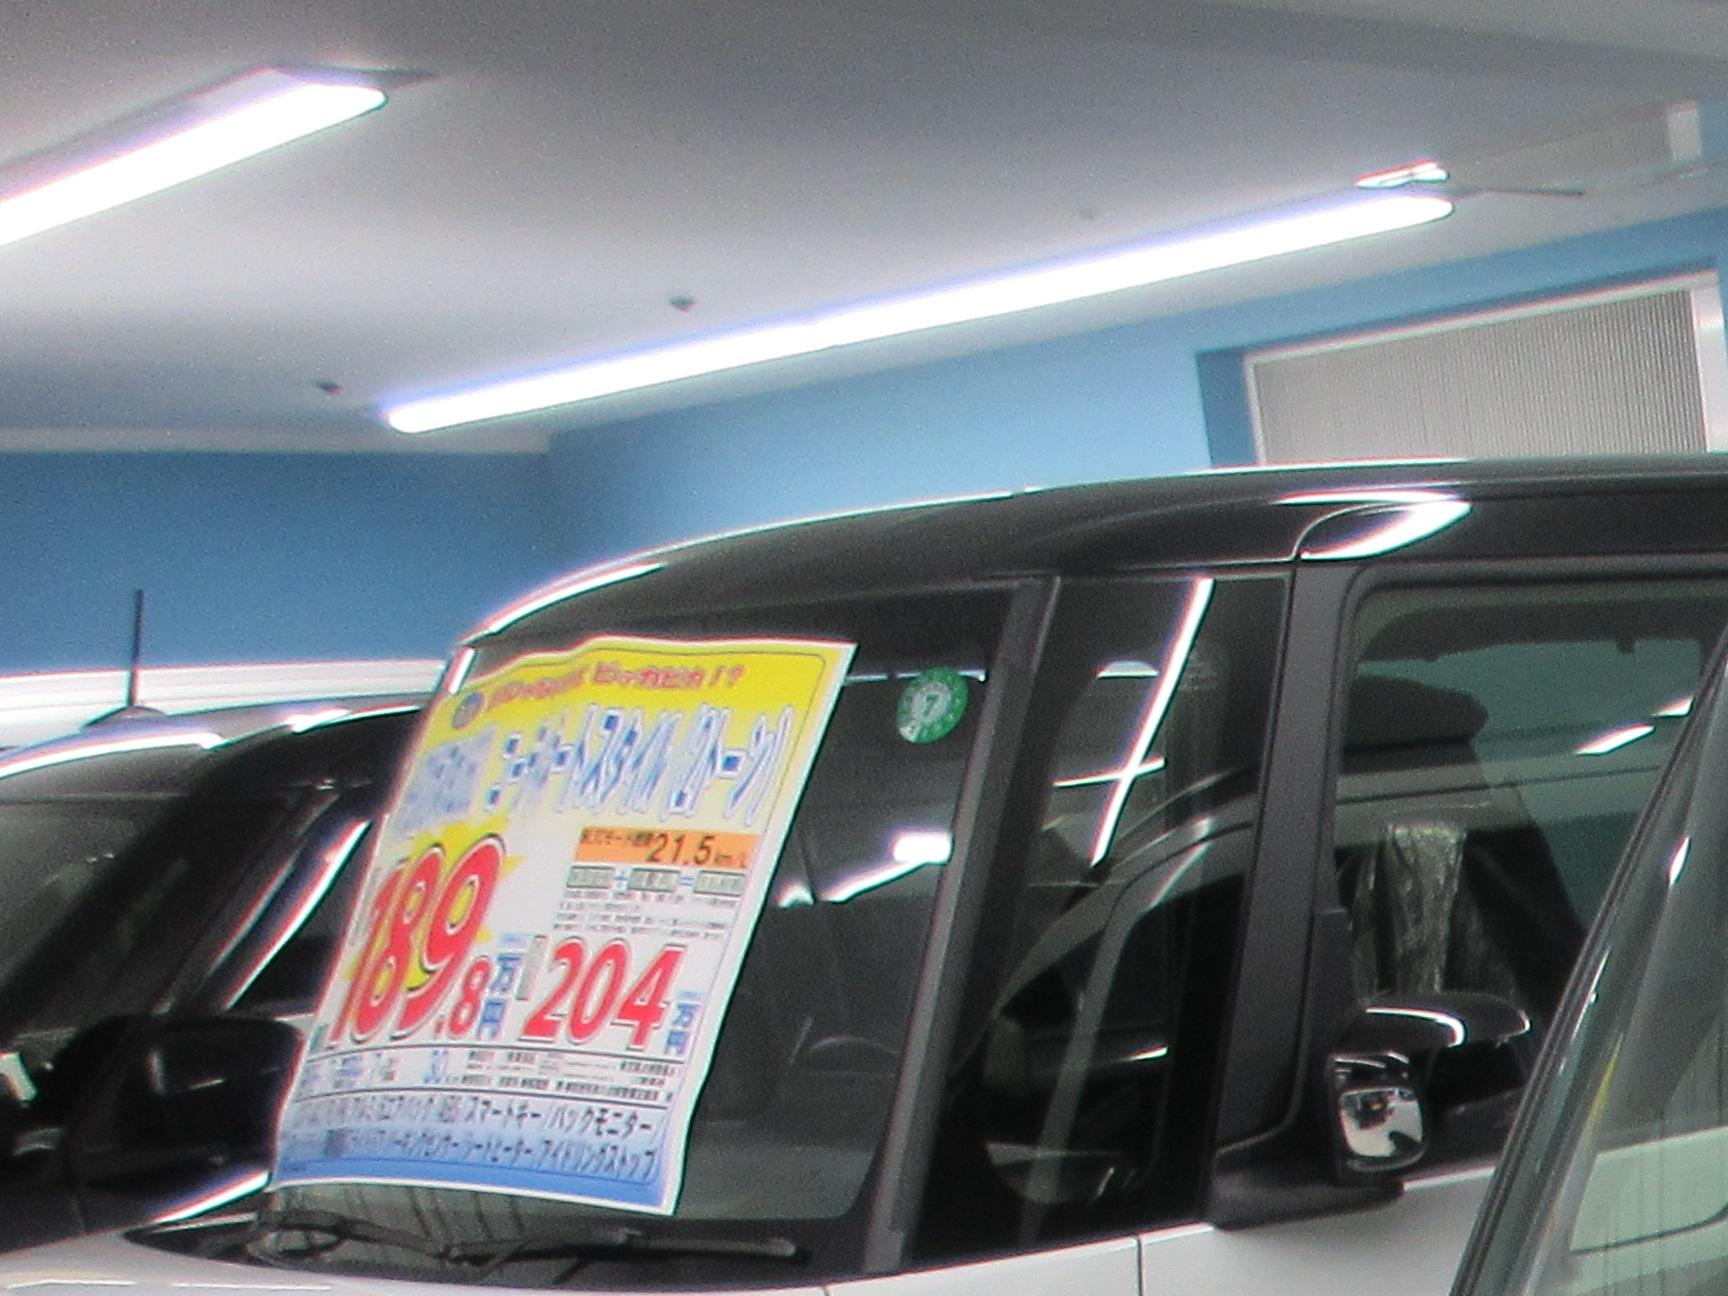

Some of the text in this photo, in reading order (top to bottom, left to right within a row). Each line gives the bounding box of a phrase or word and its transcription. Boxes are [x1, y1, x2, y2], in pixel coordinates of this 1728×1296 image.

[925, 693, 941, 717] 7
[646, 831, 715, 866] 21.5
[519, 936, 687, 1051] 204
[545, 1102, 653, 1140] バックモニター
